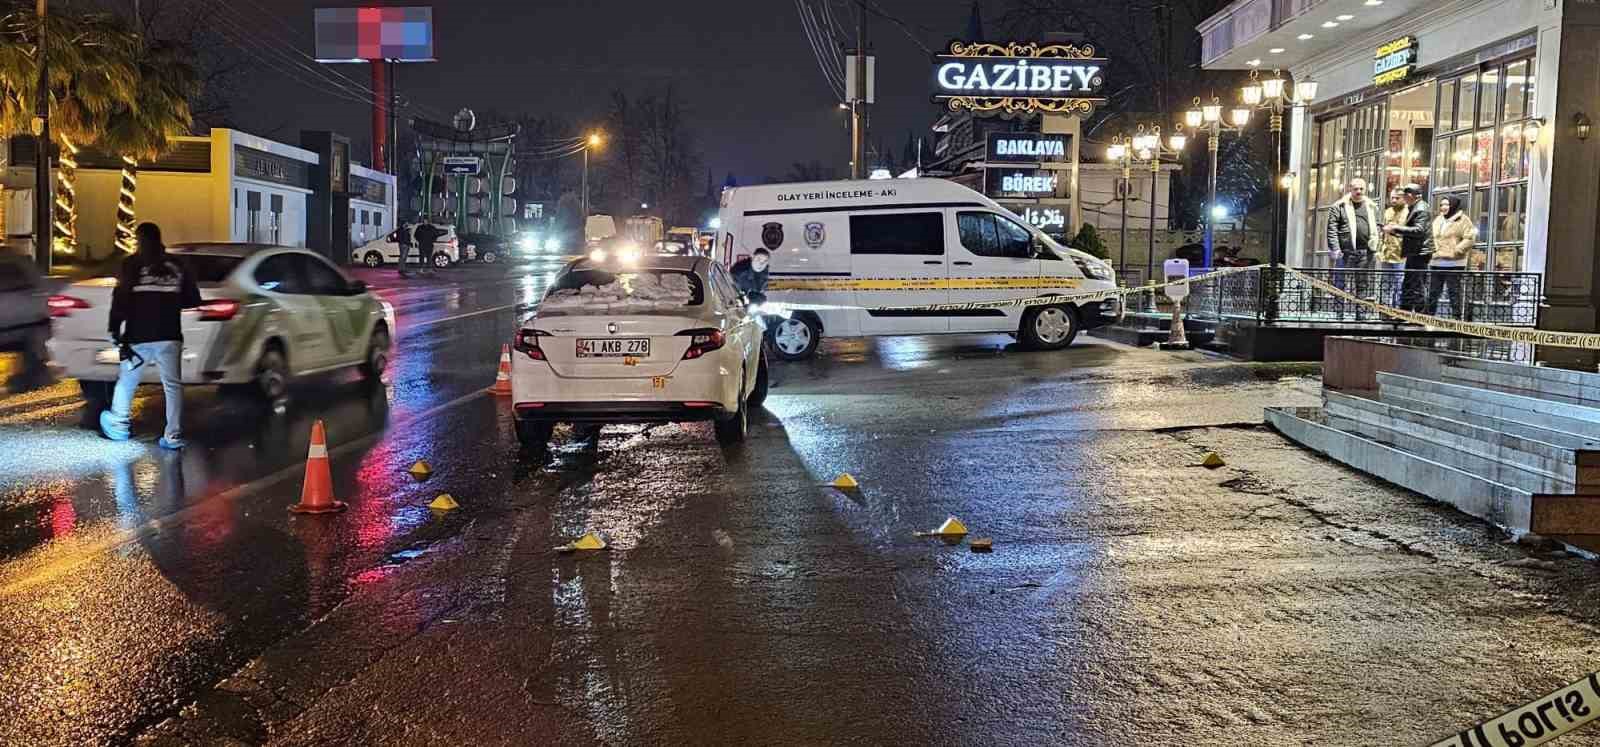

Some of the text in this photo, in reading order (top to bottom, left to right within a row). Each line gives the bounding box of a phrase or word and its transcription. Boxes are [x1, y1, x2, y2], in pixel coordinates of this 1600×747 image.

[937, 59, 1101, 91] GAZİBEY
[996, 139, 1065, 156] BAKLAVA
[1002, 173, 1054, 192] BÖREK
[777, 193, 801, 202] OLAY
[826, 190, 873, 200] İNCELEME
[583, 341, 648, 353] 41 AKB 278
